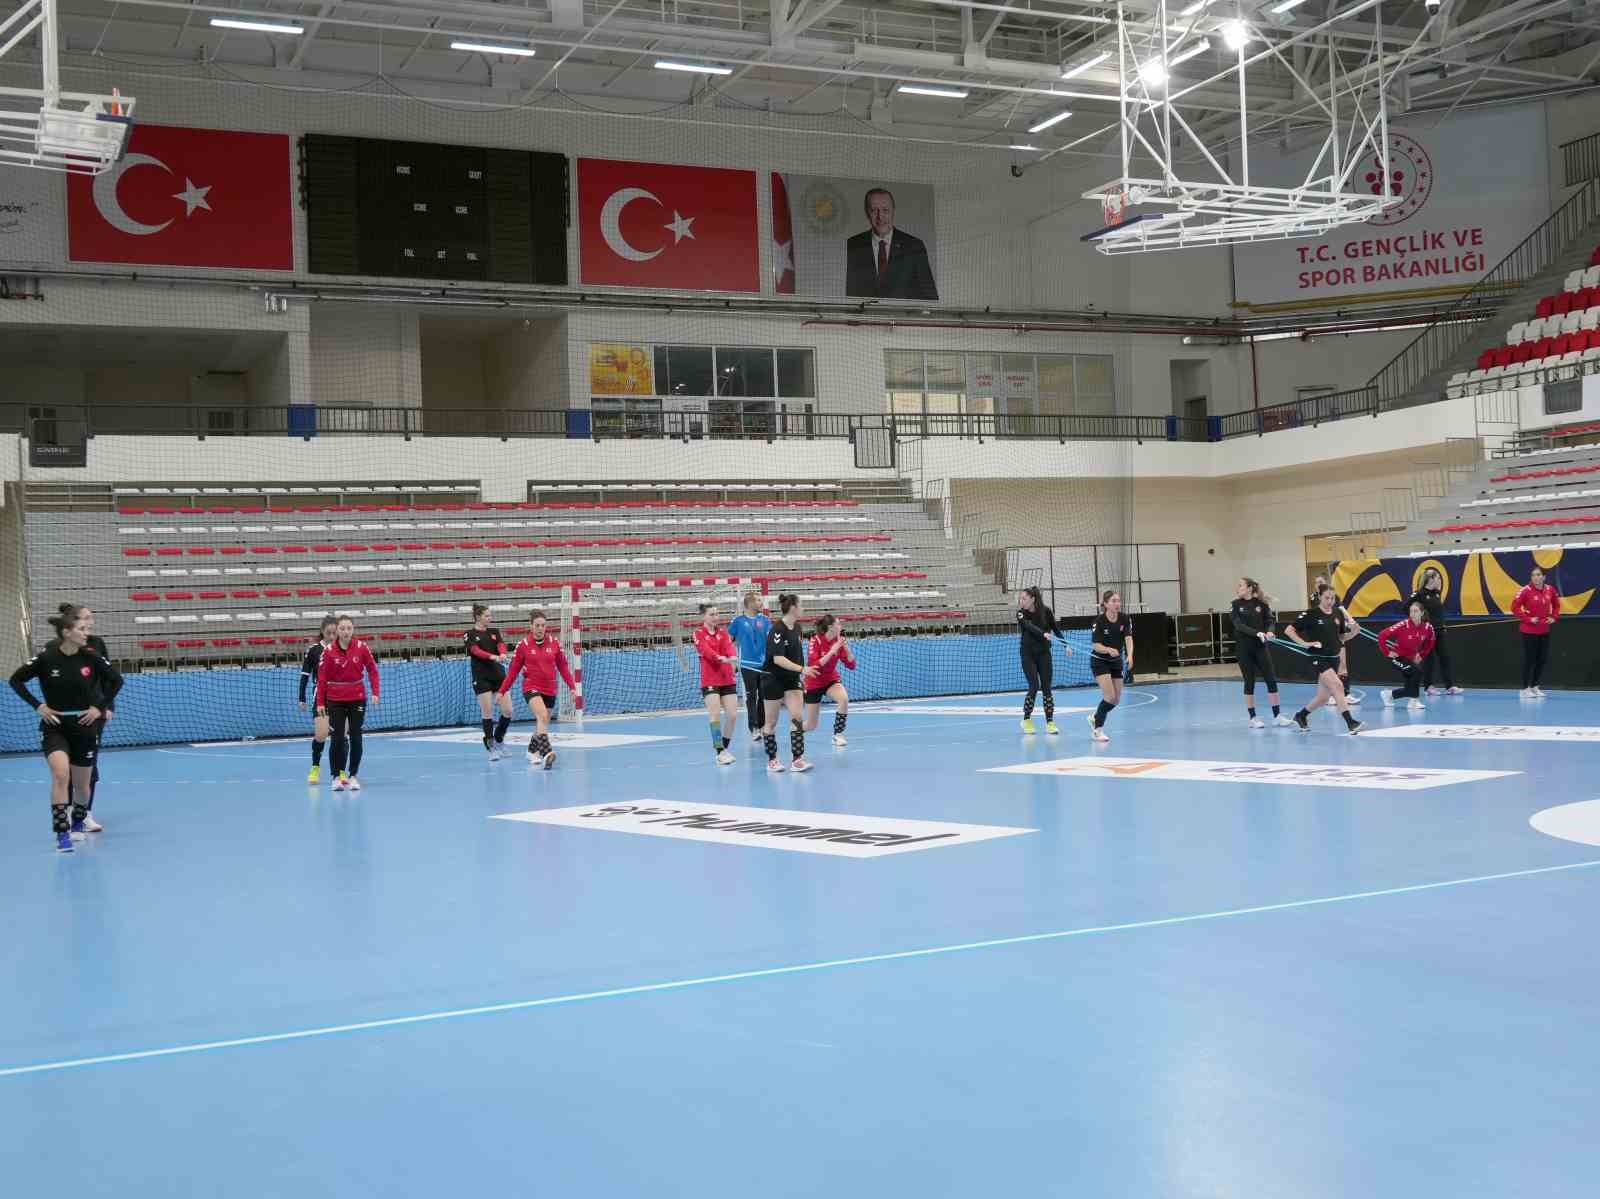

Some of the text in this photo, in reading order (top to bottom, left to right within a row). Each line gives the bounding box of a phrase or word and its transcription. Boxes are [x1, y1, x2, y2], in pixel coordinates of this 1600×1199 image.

[1296, 228, 1484, 264] T.C. GENÇLİK VE
[1298, 251, 1485, 288] SPOR BAKANLIĞI
[639, 812, 961, 847] hummel
